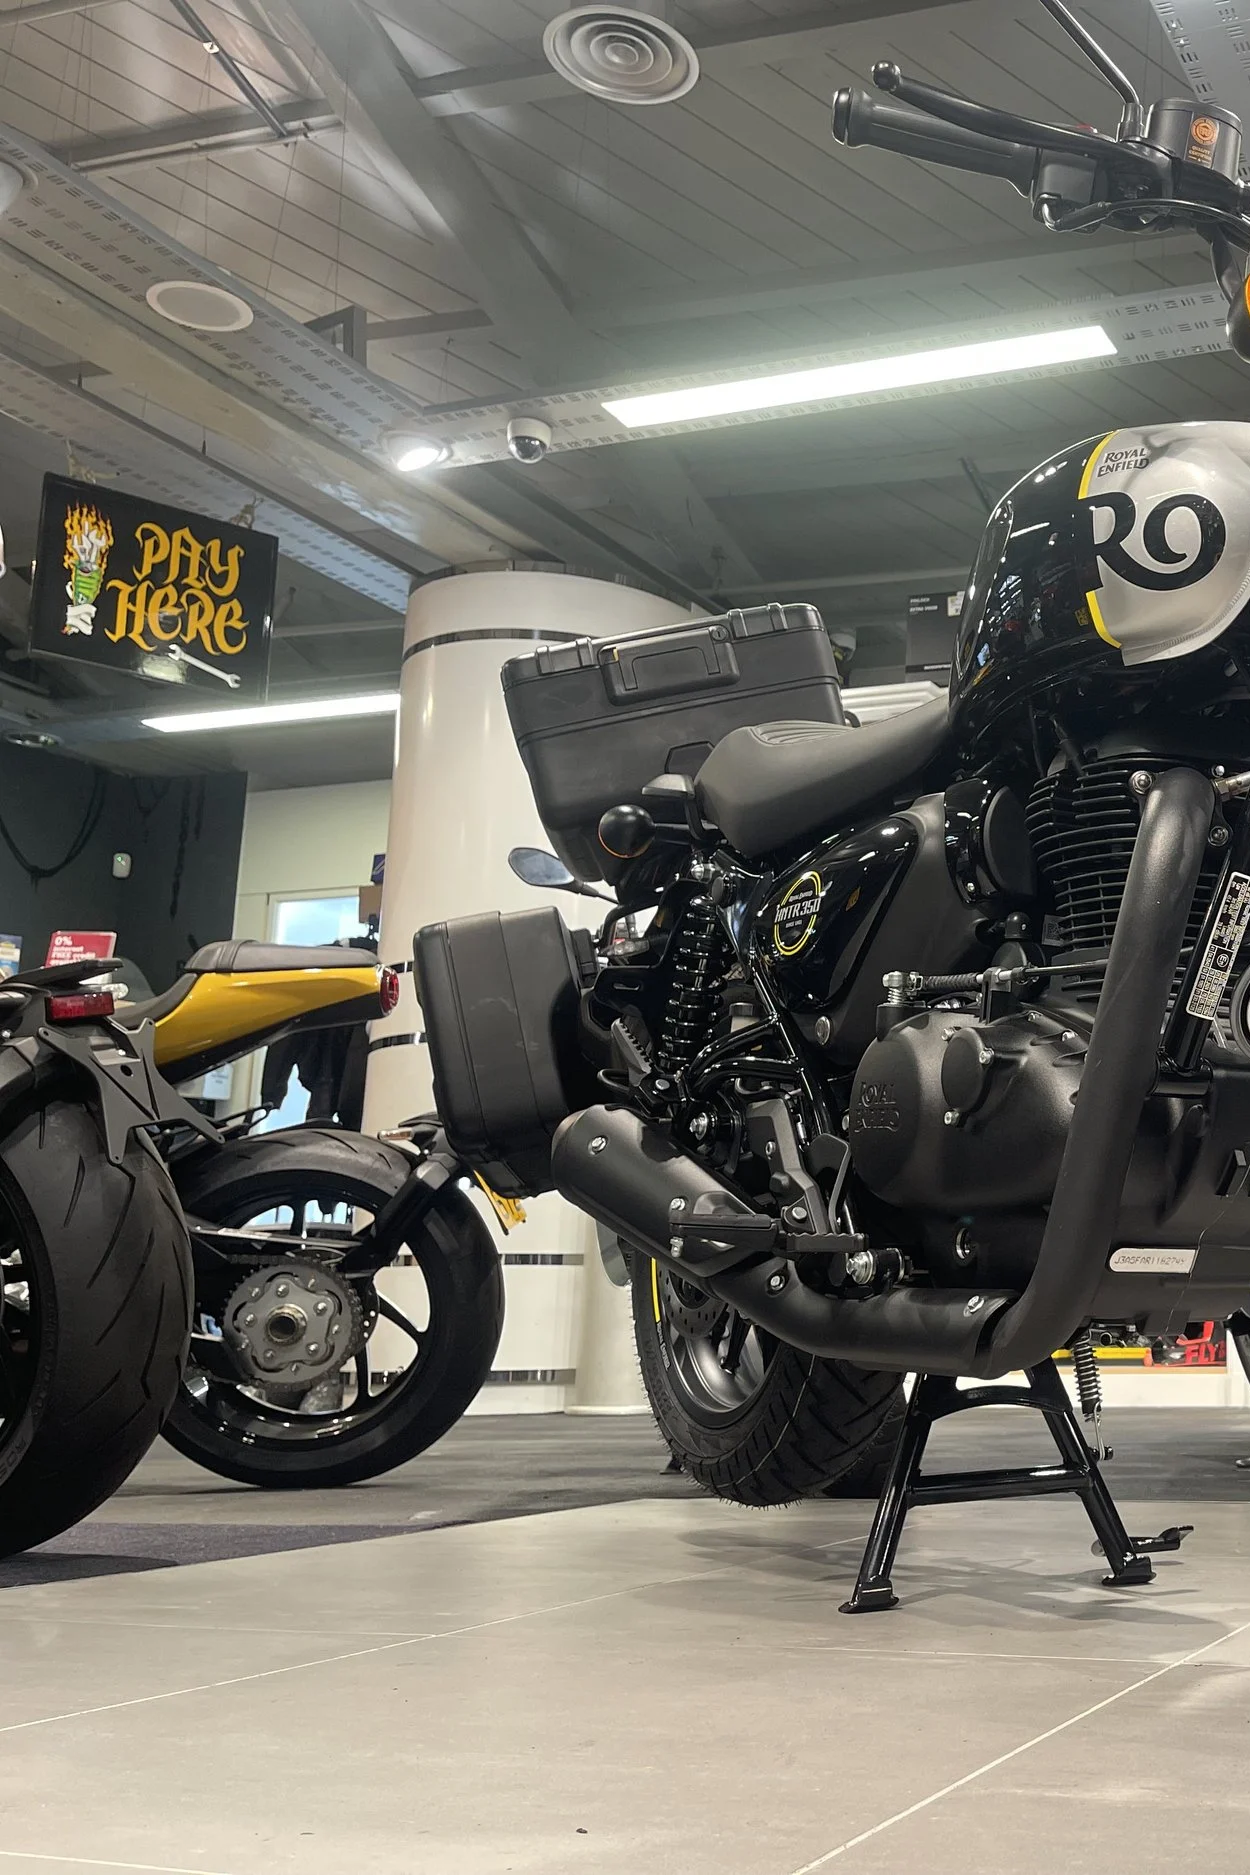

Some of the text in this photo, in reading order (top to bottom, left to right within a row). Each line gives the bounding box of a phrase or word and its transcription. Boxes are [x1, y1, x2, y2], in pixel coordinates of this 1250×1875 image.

[1104, 448, 1147, 463] ROYAL
[1097, 457, 1149, 477] ENFIELD
[133, 522, 245, 597] PAY
[104, 579, 249, 656] HERE
[800, 897, 821, 916] 350
[54, 936, 73, 946] 0%
